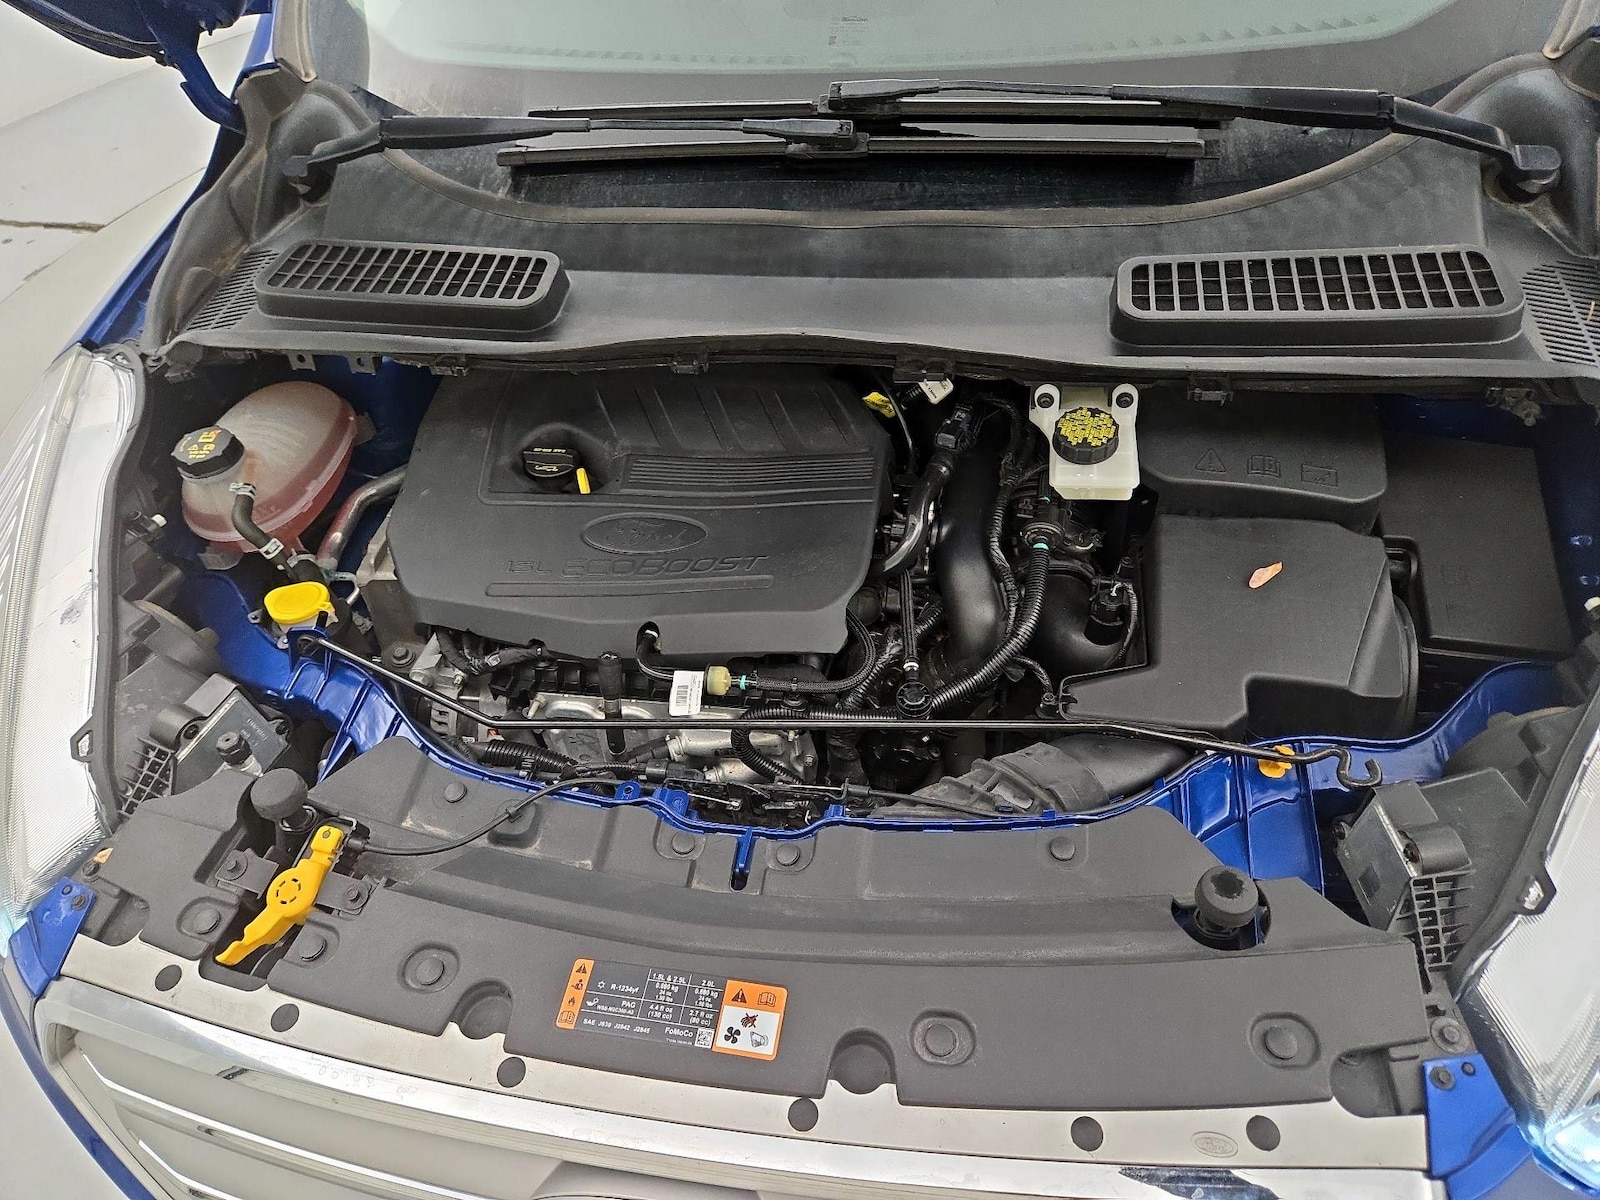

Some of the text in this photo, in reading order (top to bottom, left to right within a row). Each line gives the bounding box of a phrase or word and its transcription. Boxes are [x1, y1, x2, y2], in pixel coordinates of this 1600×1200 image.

[560, 555, 770, 578] ECOBOOST
[610, 983, 639, 994] R-1234yf
[621, 1000, 636, 1008] PAG
[583, 1018, 597, 1026] SAE
[664, 1026, 693, 1038] FoMoCo
